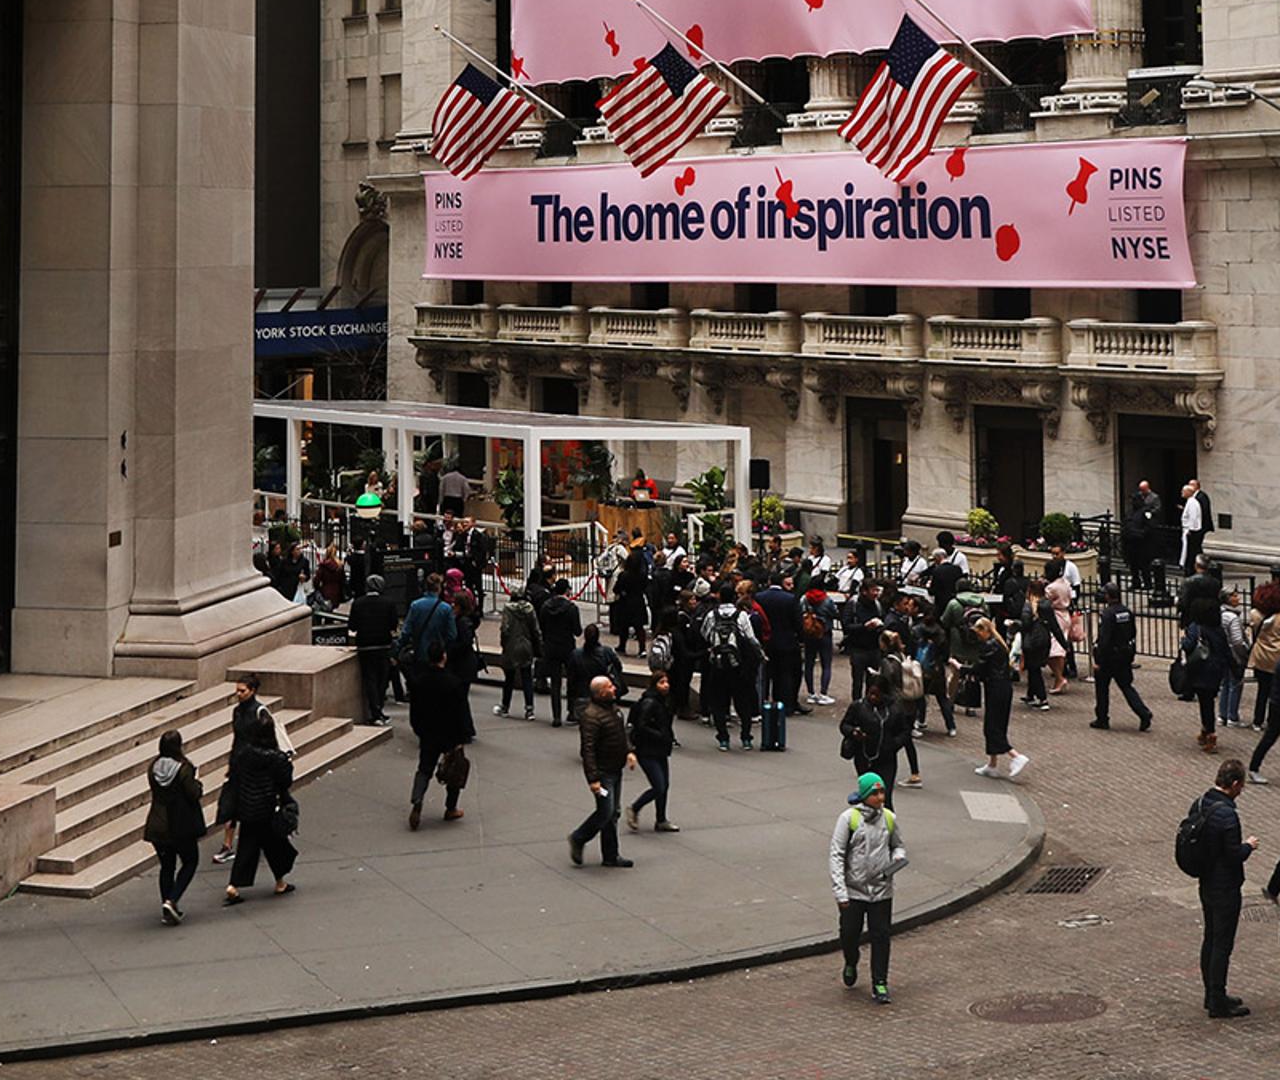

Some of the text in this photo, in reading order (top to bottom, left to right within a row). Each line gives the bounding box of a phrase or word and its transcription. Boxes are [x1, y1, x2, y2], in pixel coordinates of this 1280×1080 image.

[1109, 166, 1162, 191] PINS
[434, 192, 463, 210] PINS
[530, 180, 993, 252] The home of inspiration
[1108, 205, 1166, 222] LISTED
[434, 220, 464, 233] LISTED
[433, 242, 464, 260] NYSE
[1111, 236, 1171, 260] NYSE
[255, 322, 389, 340] YORK STOCK EXCHANGE
